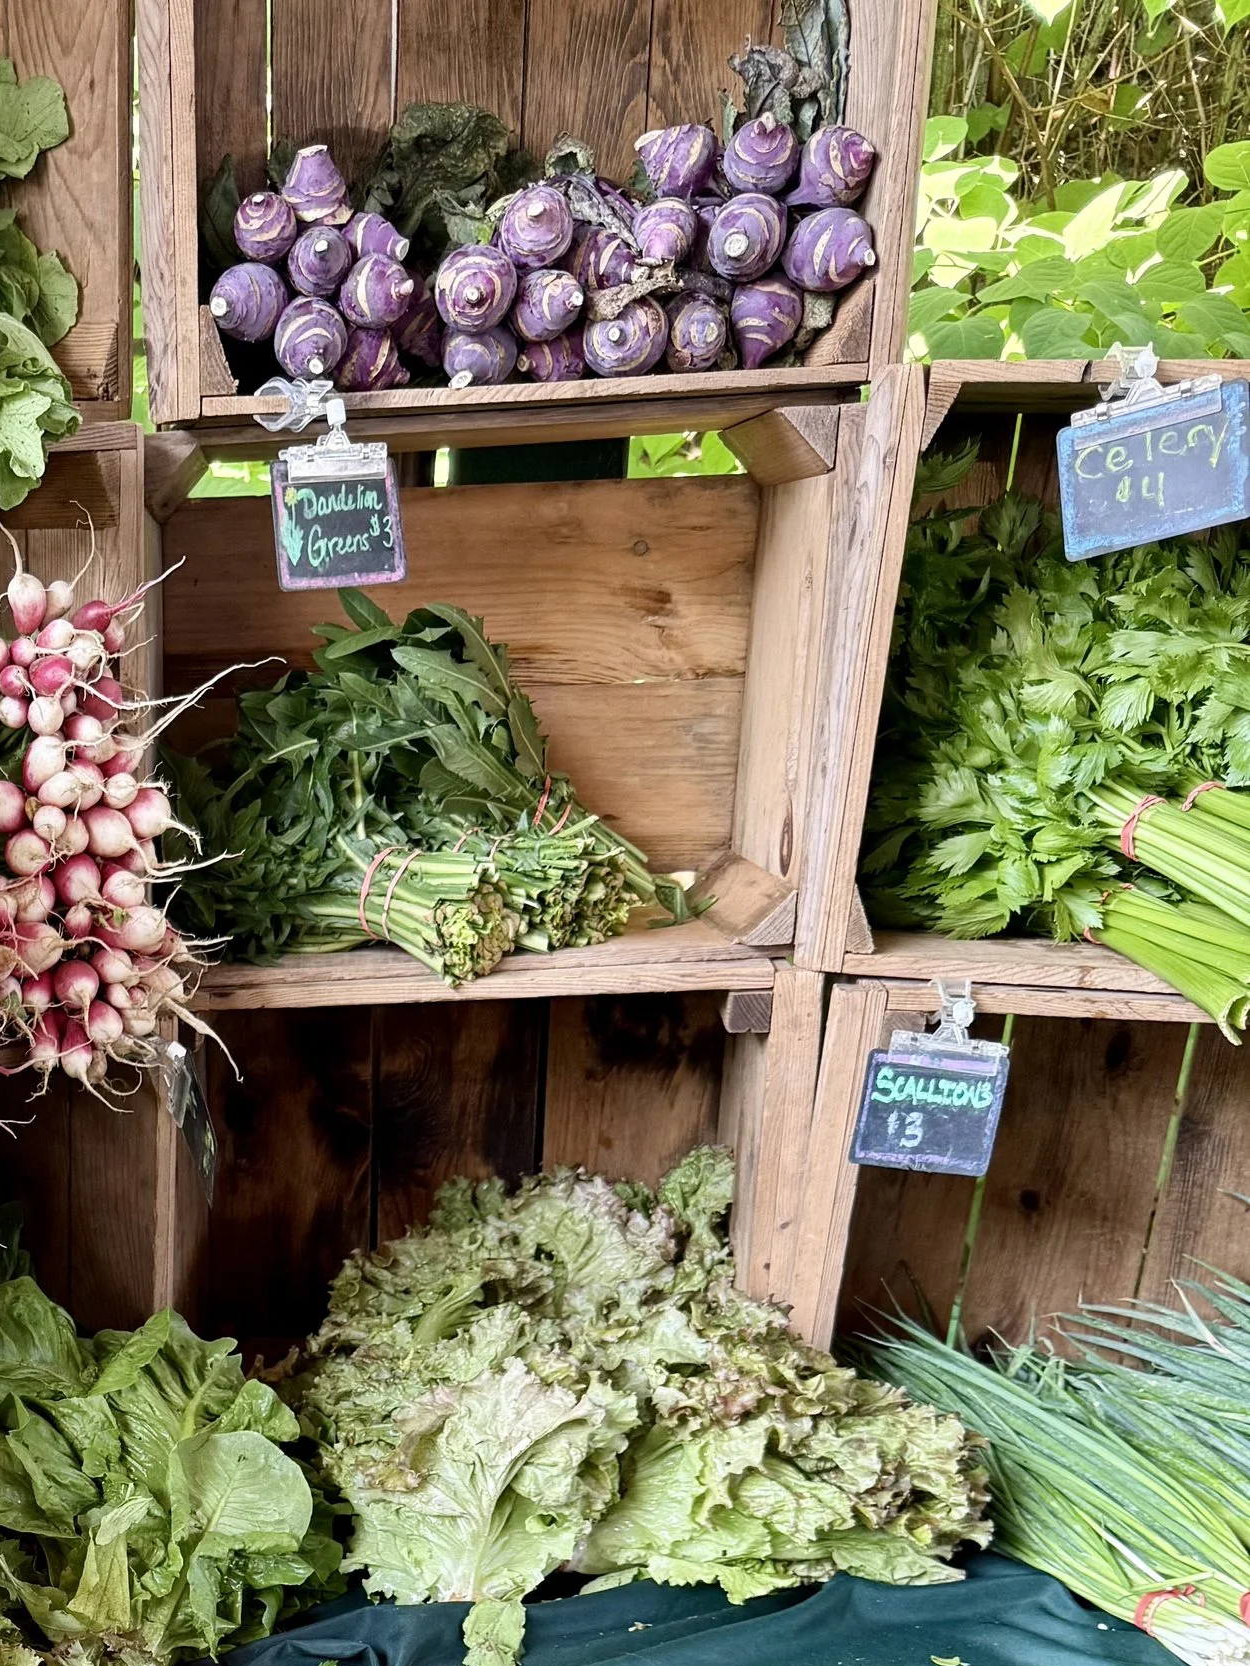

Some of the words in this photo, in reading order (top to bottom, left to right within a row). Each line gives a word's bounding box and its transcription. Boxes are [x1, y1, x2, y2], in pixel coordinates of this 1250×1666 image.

[1075, 414, 1230, 478] Celery
[296, 484, 382, 520] Dandelion
[307, 523, 370, 567] Greens
